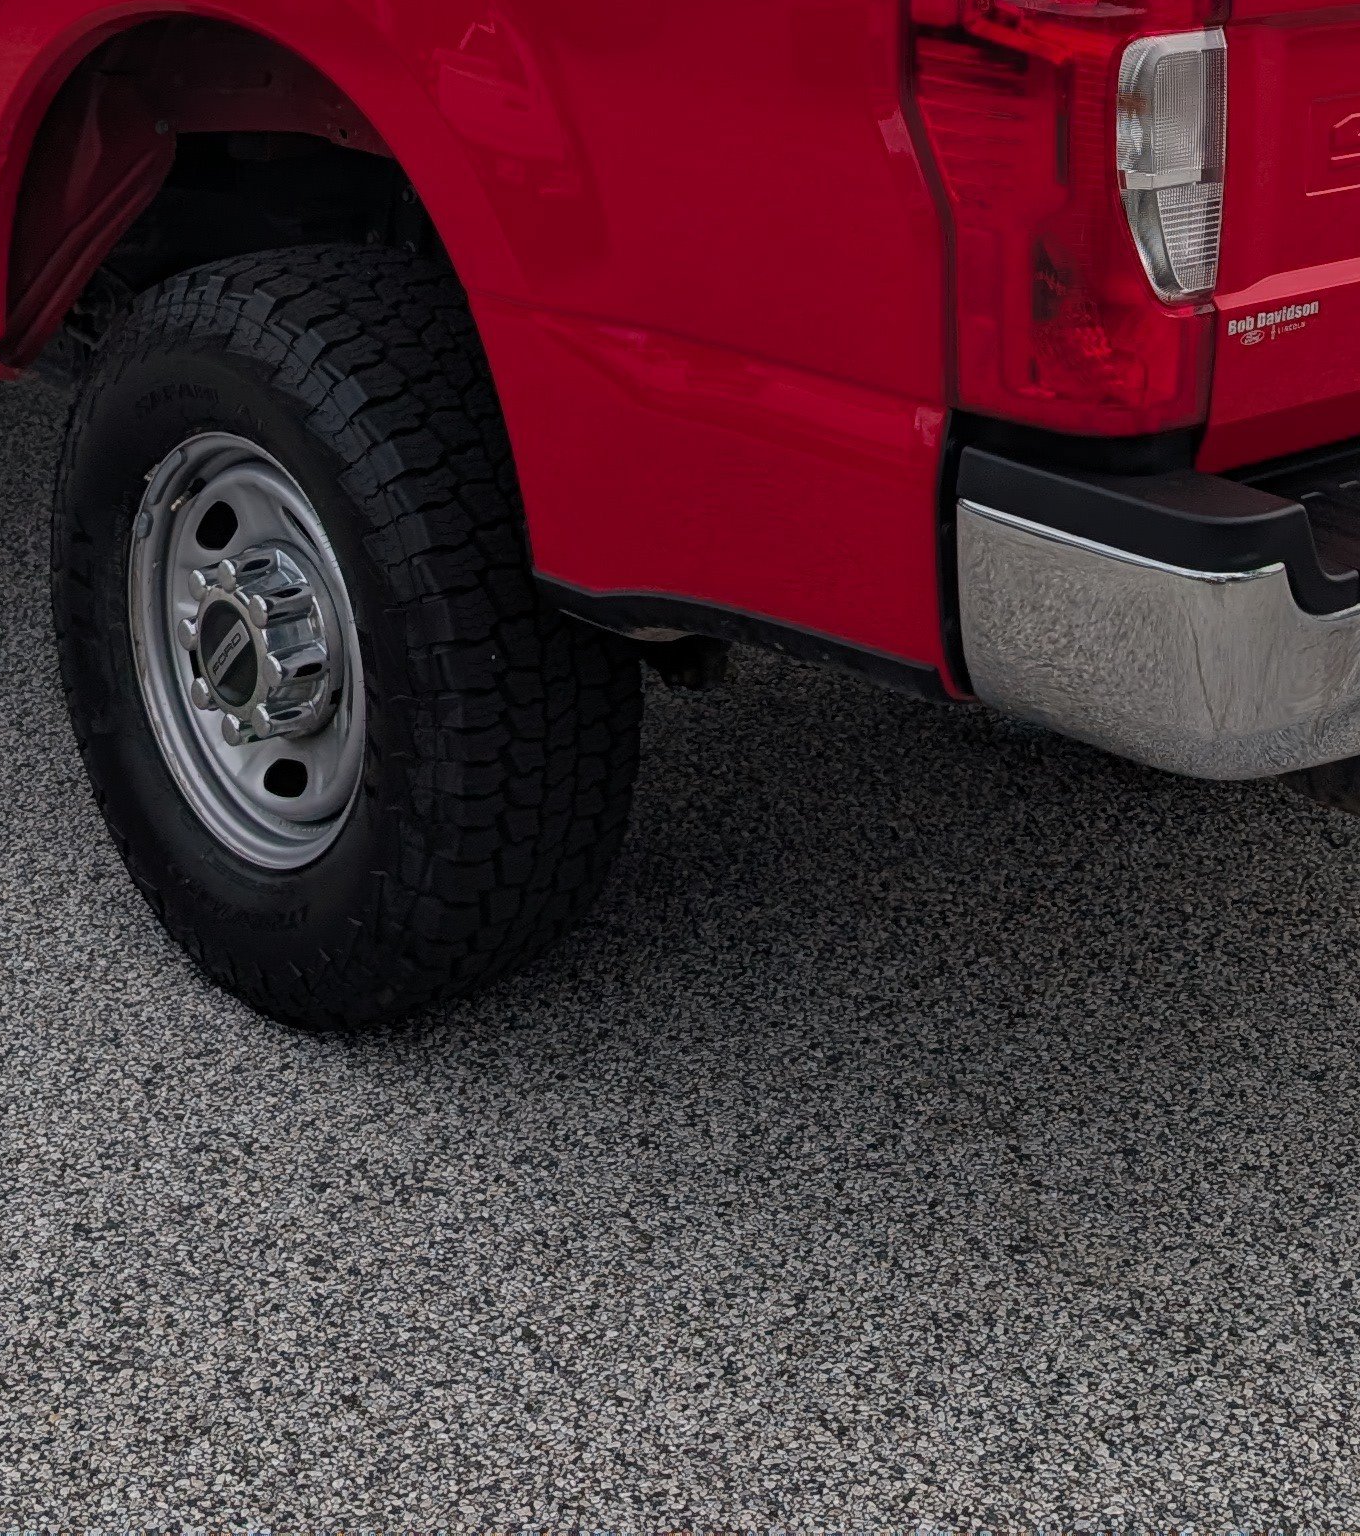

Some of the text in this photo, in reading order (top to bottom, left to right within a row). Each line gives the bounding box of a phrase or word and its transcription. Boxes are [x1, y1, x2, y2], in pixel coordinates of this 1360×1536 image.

[1228, 301, 1320, 336] Bob Davidson
[212, 632, 242, 676] FORD
